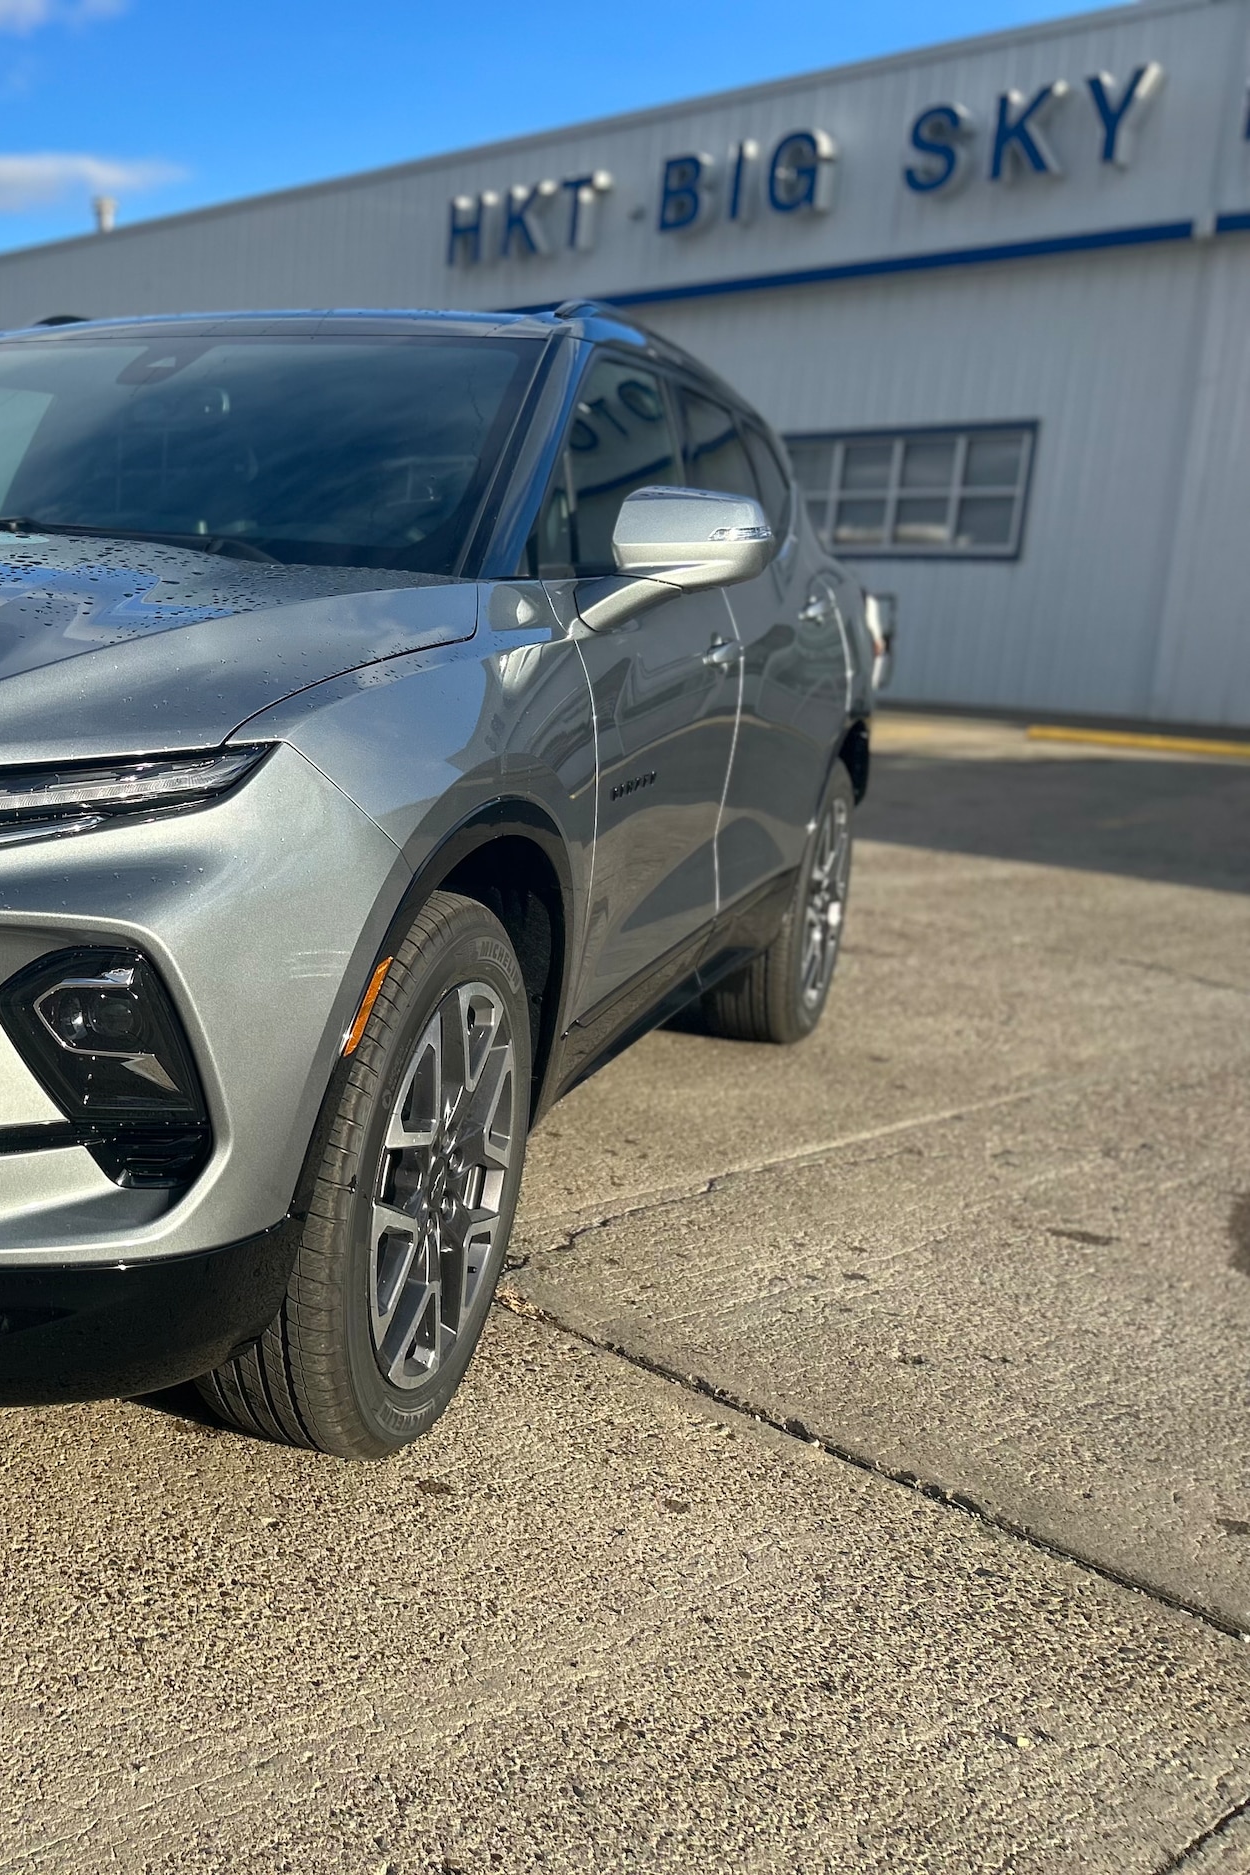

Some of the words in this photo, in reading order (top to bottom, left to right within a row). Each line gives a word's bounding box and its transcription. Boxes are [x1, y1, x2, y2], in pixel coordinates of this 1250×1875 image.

[447, 171, 612, 267] HKT
[659, 128, 836, 232] BIG
[904, 61, 1161, 194] SKY
